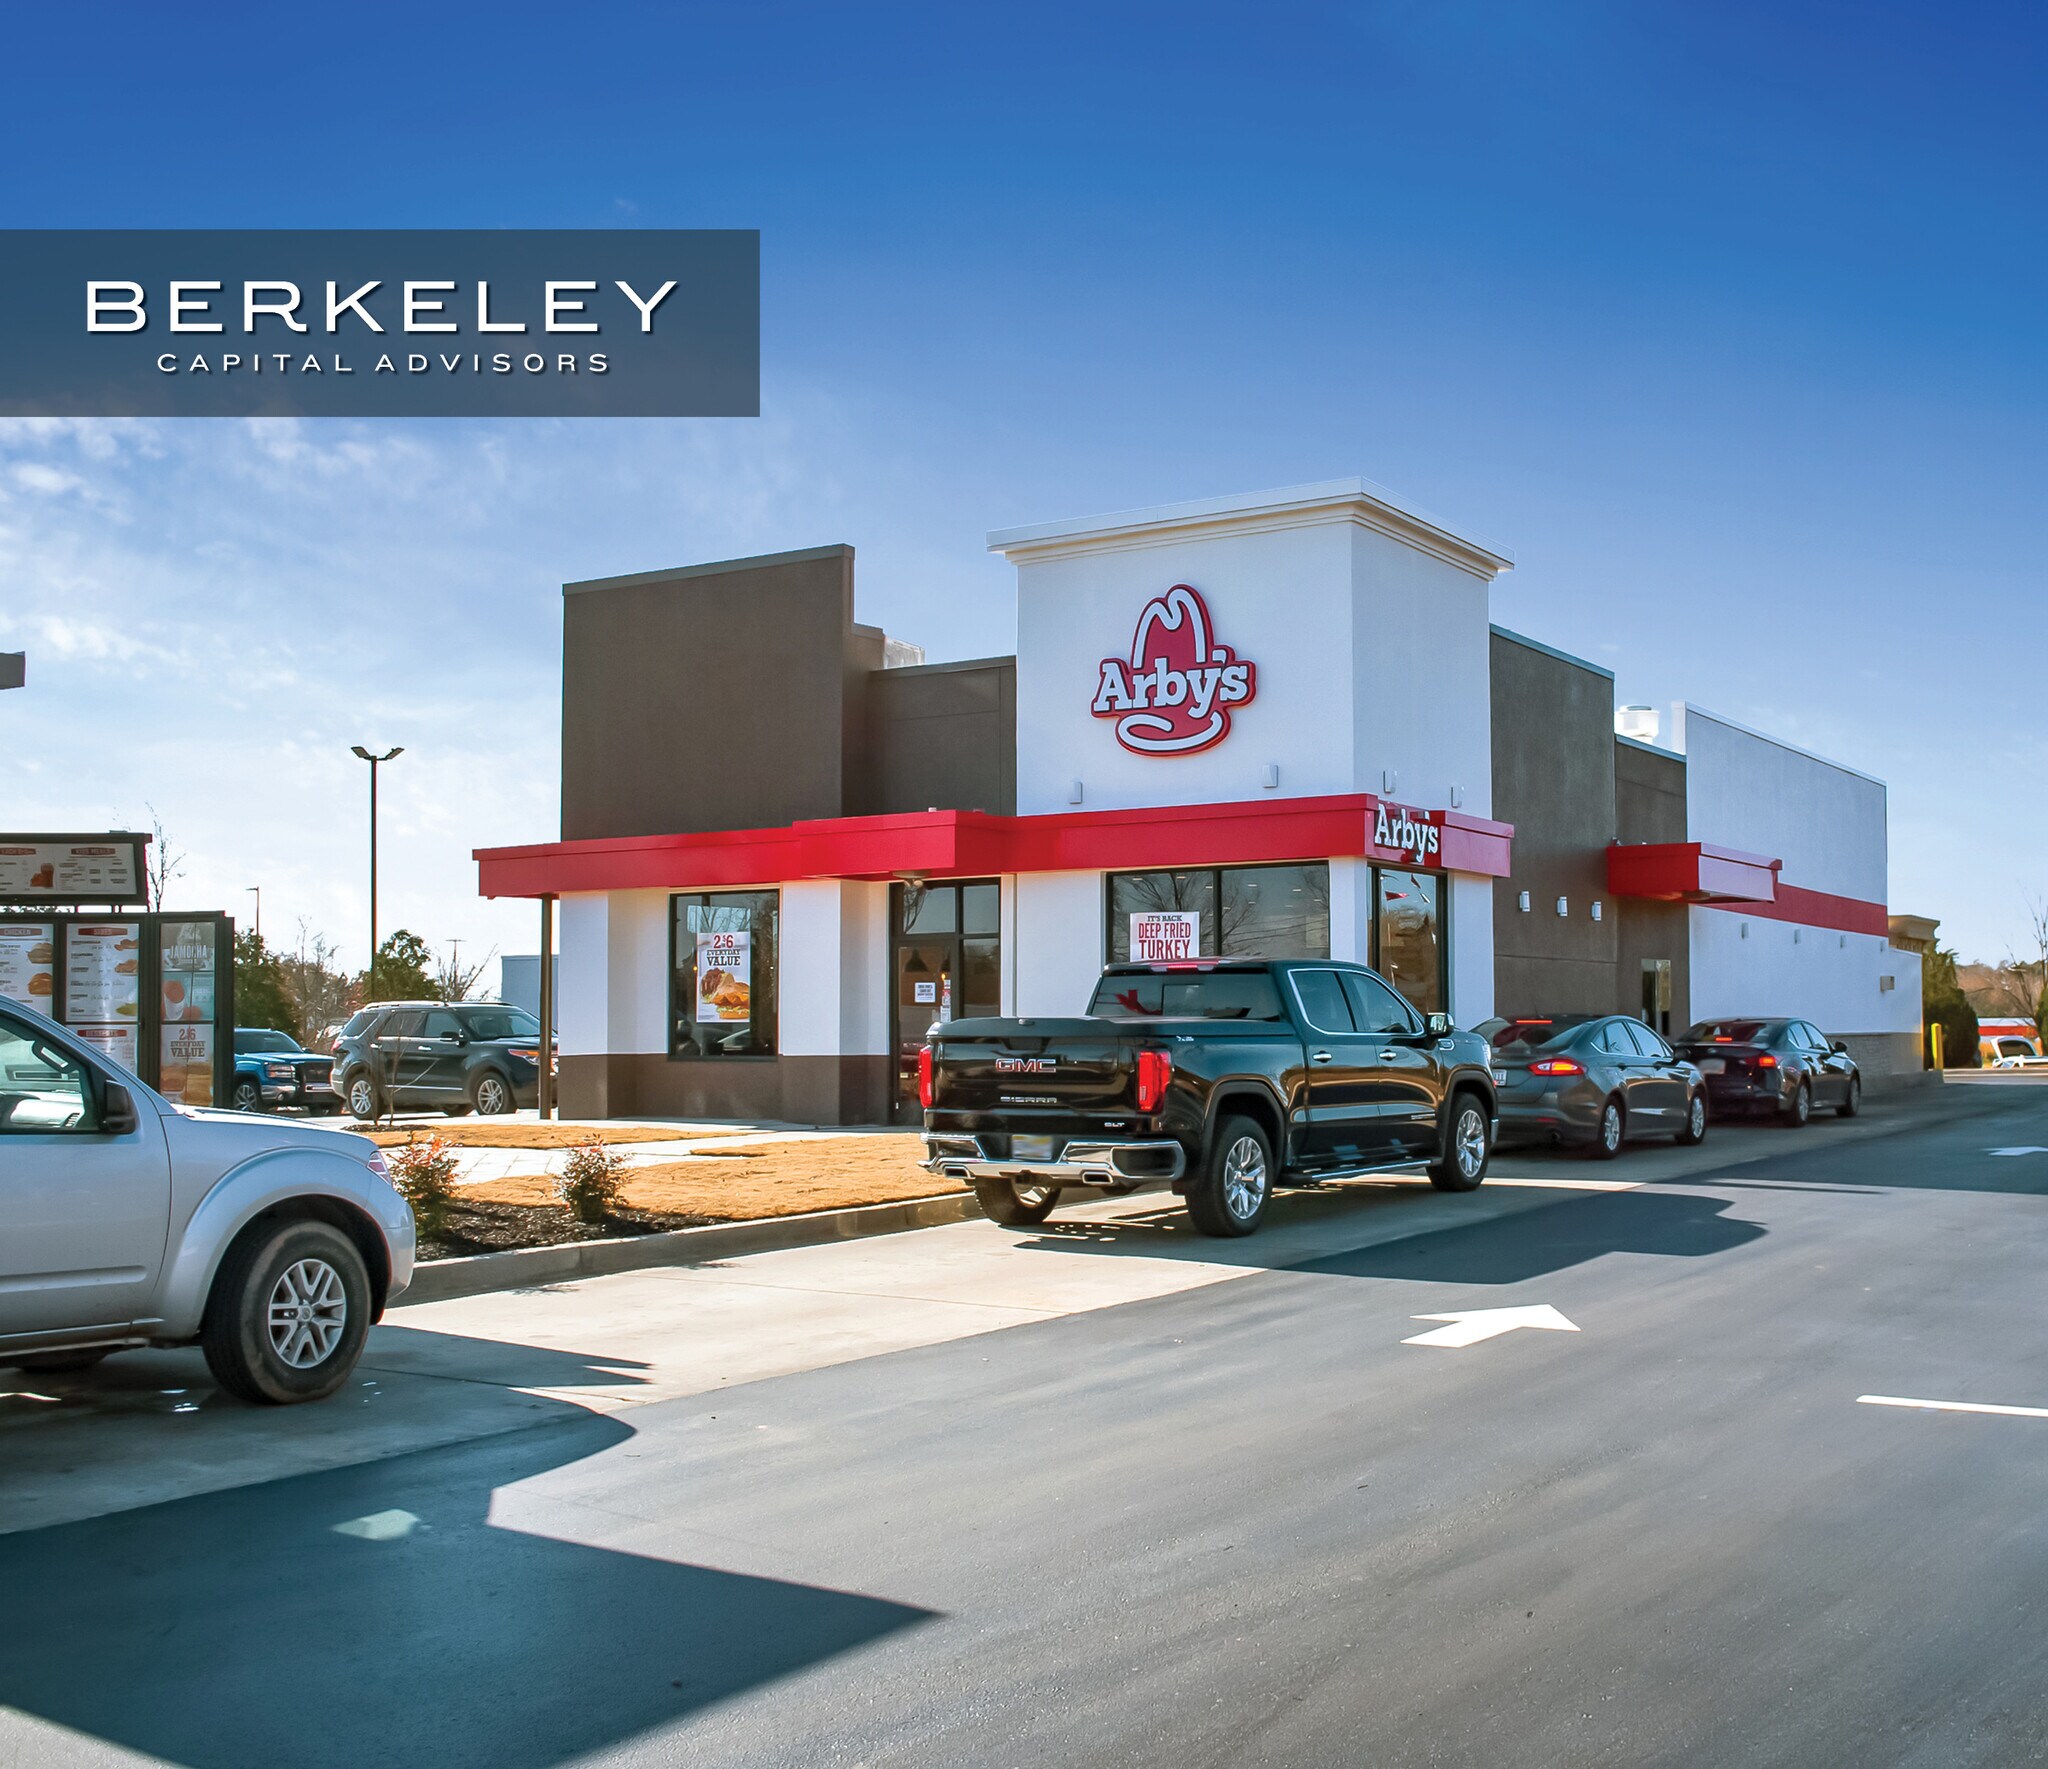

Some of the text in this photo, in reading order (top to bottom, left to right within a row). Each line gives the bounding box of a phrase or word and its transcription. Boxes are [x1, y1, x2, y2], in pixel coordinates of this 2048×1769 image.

[1093, 649, 1249, 719] Arby's
[1374, 803, 1439, 864] Arby's
[1138, 922, 1191, 938] DEEP FRIED
[1138, 939, 1191, 960] TURKEY
[707, 956, 741, 966] VALUE
[170, 1048, 206, 1058] VALUE
[995, 1058, 1057, 1073] GMC
[1000, 1096, 1058, 1104] SIERRA
